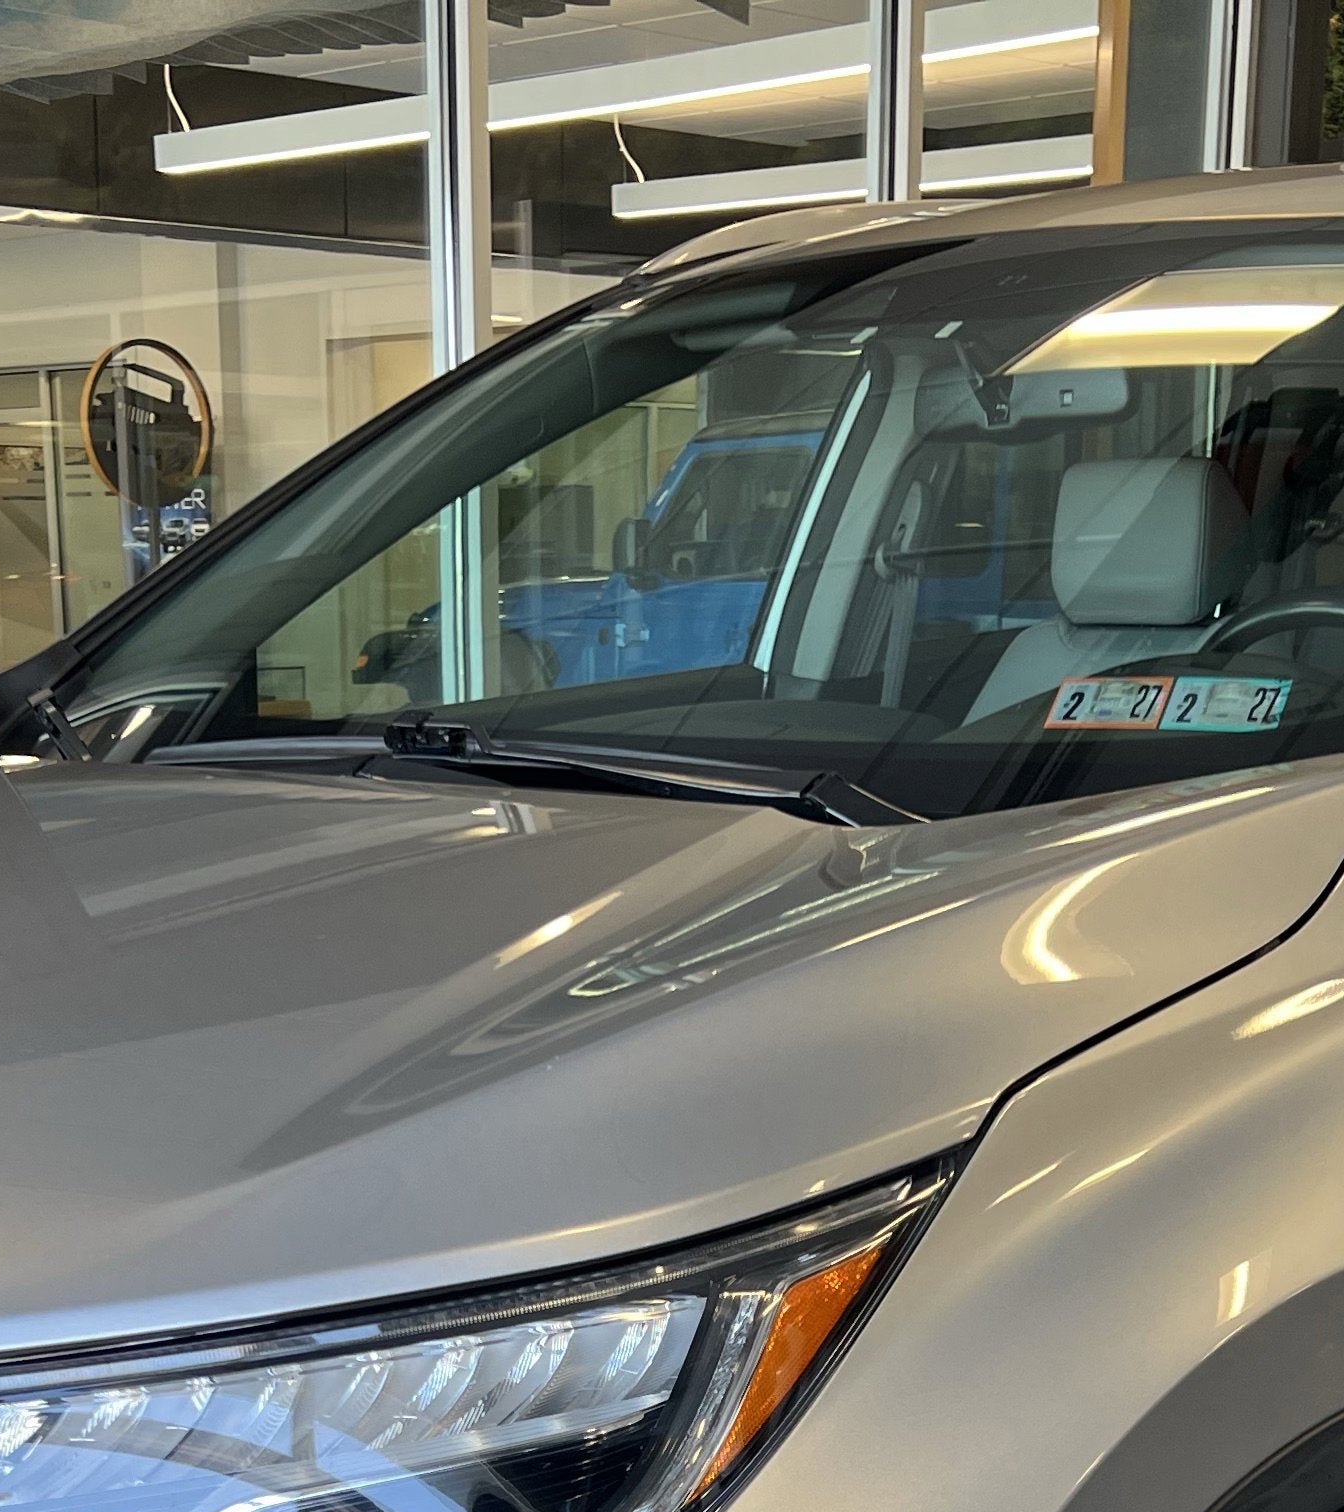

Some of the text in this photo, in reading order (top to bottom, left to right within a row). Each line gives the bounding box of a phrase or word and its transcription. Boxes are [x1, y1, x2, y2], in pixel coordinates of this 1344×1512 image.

[1062, 691, 1086, 721] 2
[1129, 684, 1163, 722] 27
[1175, 693, 1199, 724] 2
[1246, 687, 1282, 724] 27
